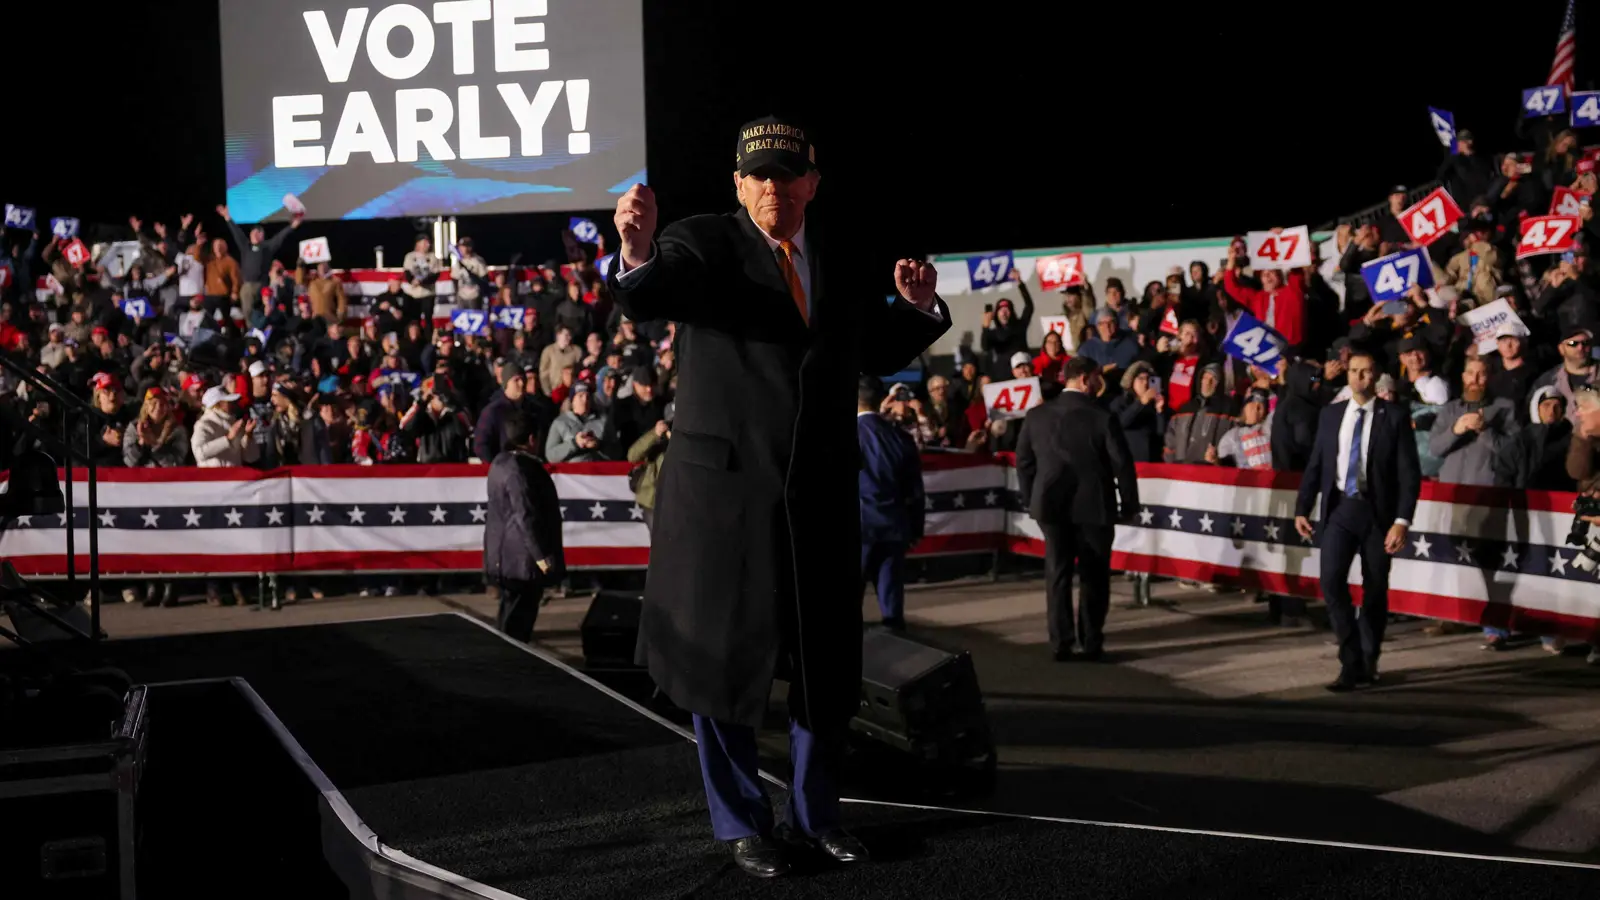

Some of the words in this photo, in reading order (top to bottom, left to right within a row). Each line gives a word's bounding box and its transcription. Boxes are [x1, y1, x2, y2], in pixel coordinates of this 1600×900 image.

[303, 0, 550, 83] VOTE
[1526, 88, 1559, 111] 47
[1577, 97, 1600, 120] 4
[272, 79, 591, 168] EARLY!
[742, 124, 765, 141] MAKE
[767, 124, 804, 139] AMERICA
[1431, 112, 1454, 147] 4
[745, 138, 772, 153] GREAT
[773, 139, 800, 153] AGAIN
[1557, 192, 1580, 216] 4
[53, 219, 76, 237] 47
[572, 219, 598, 237] 47
[1412, 197, 1448, 239] 47
[1522, 220, 1573, 247] 47
[303, 245, 321, 258] 47
[1258, 235, 1300, 261] 47
[974, 256, 1009, 284] 47
[1042, 257, 1079, 285] 47
[1376, 256, 1421, 294] 47
[124, 300, 146, 316] 47
[454, 311, 484, 331] 47
[1471, 311, 1507, 332] RUMP
[1234, 327, 1279, 362] 47
[993, 384, 1033, 413] 47
